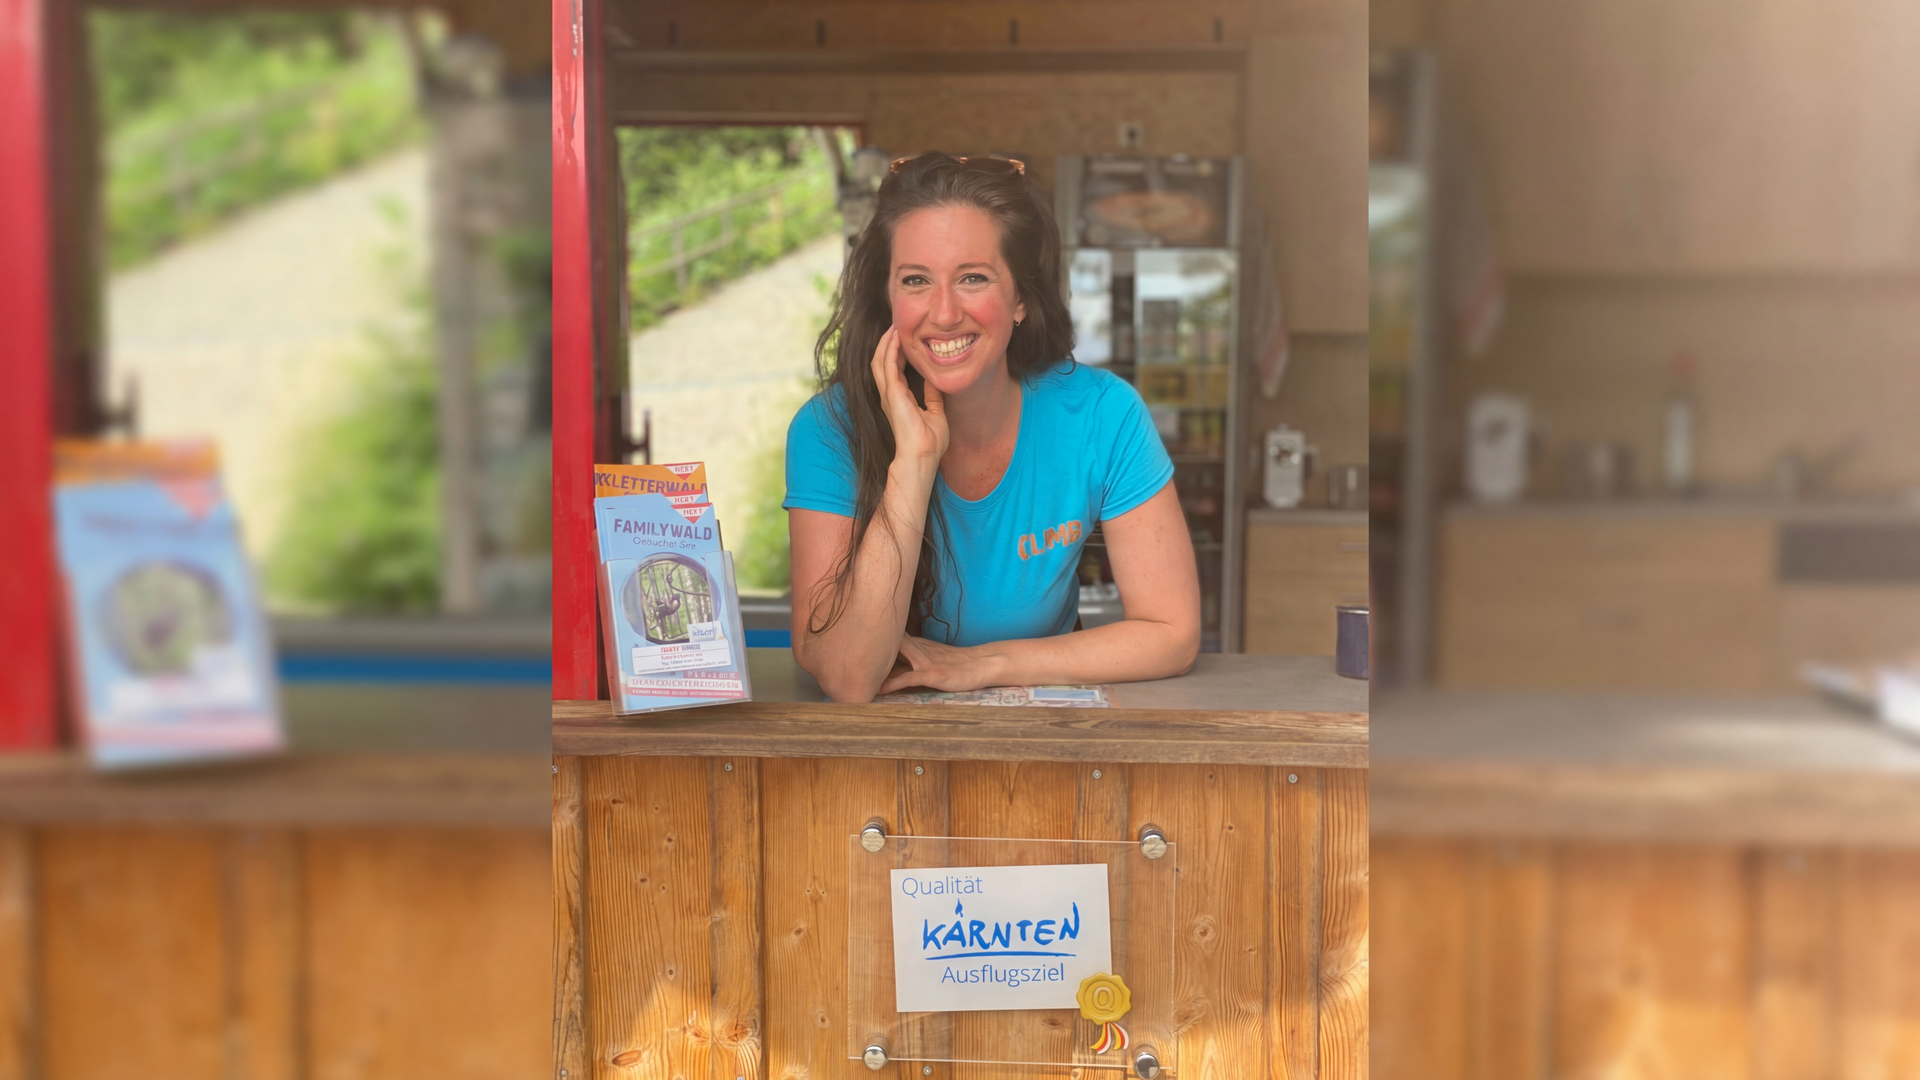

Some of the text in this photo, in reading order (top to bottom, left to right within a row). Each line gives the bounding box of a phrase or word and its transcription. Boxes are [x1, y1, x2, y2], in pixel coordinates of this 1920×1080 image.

[613, 518, 712, 541] FAMILYWALD
[1018, 520, 1082, 560] CLIMB
[901, 876, 984, 898] Qualität
[941, 963, 1065, 988] Ausflugsziel
